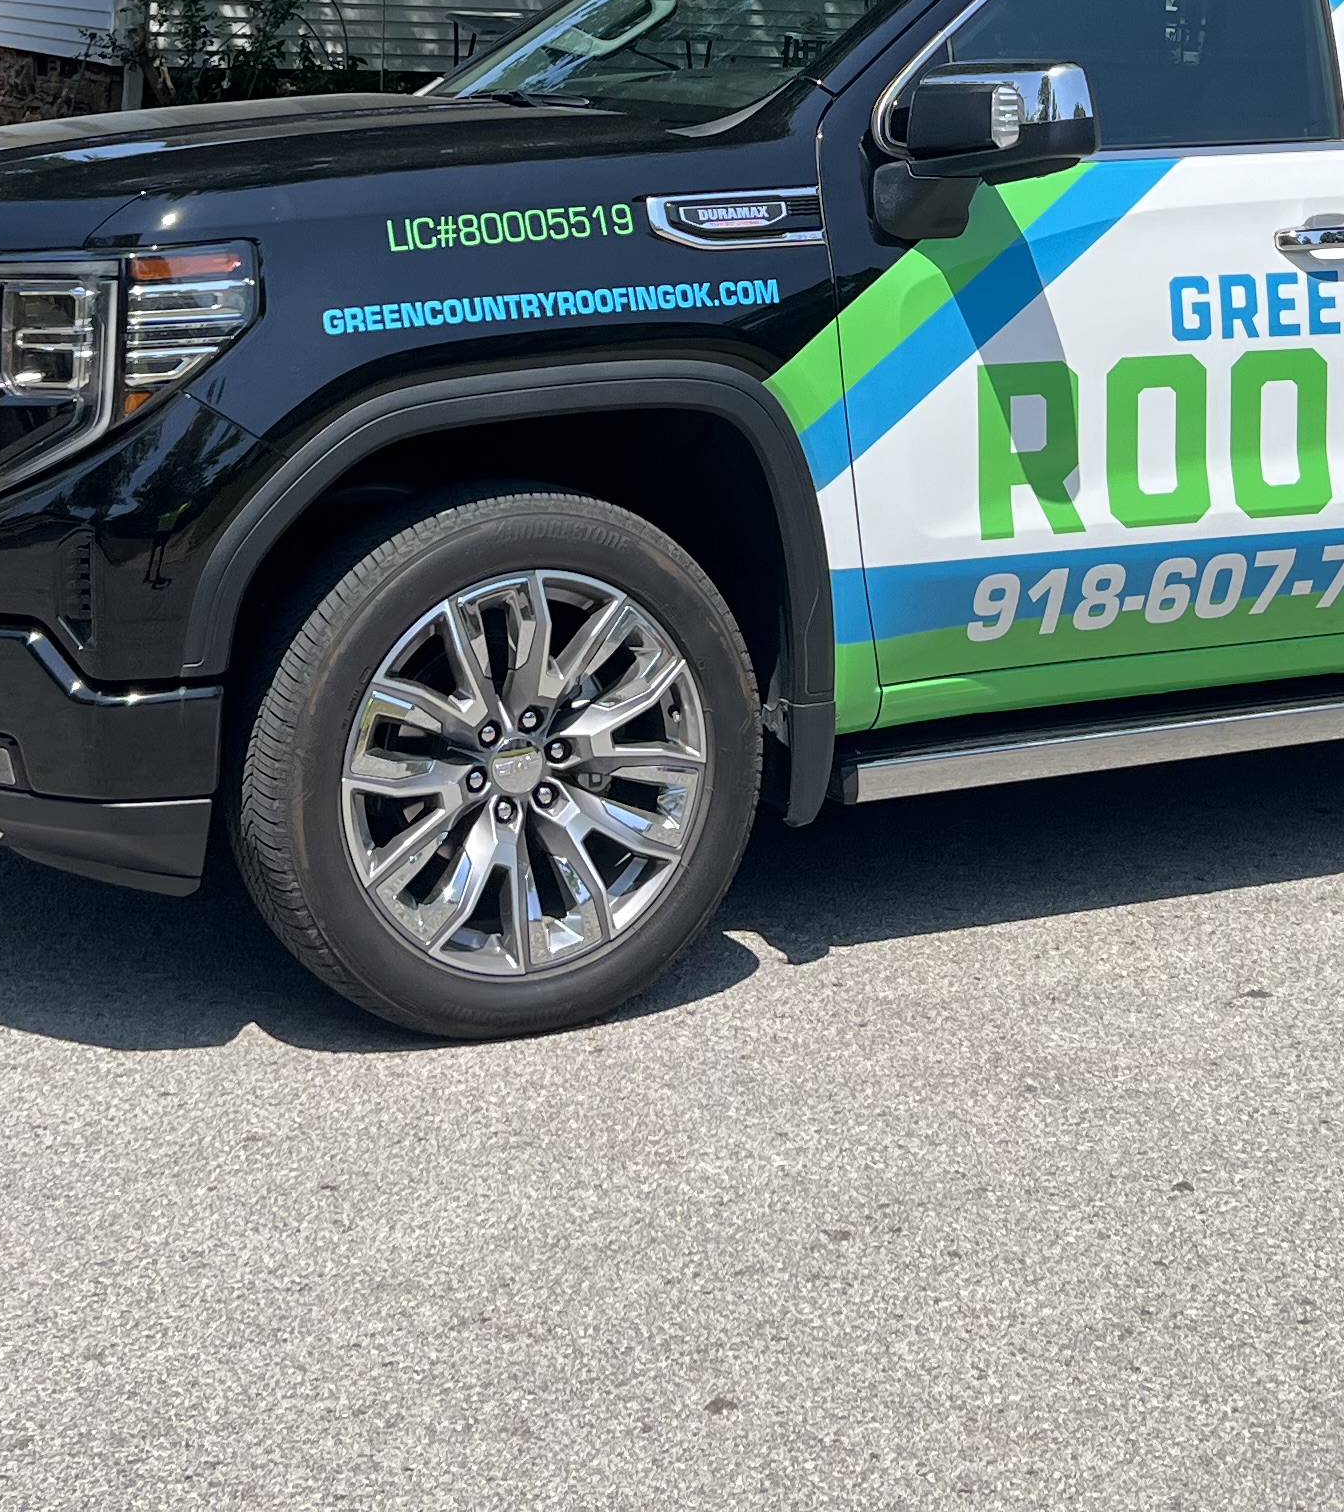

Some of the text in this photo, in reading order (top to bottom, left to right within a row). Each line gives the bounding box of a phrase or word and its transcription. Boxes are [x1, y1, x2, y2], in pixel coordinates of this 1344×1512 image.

[386, 203, 635, 252] LIC#80005519
[697, 206, 770, 221] DURAMAX
[322, 278, 780, 336] GREENCOUNTRYROOFINGOK.COM
